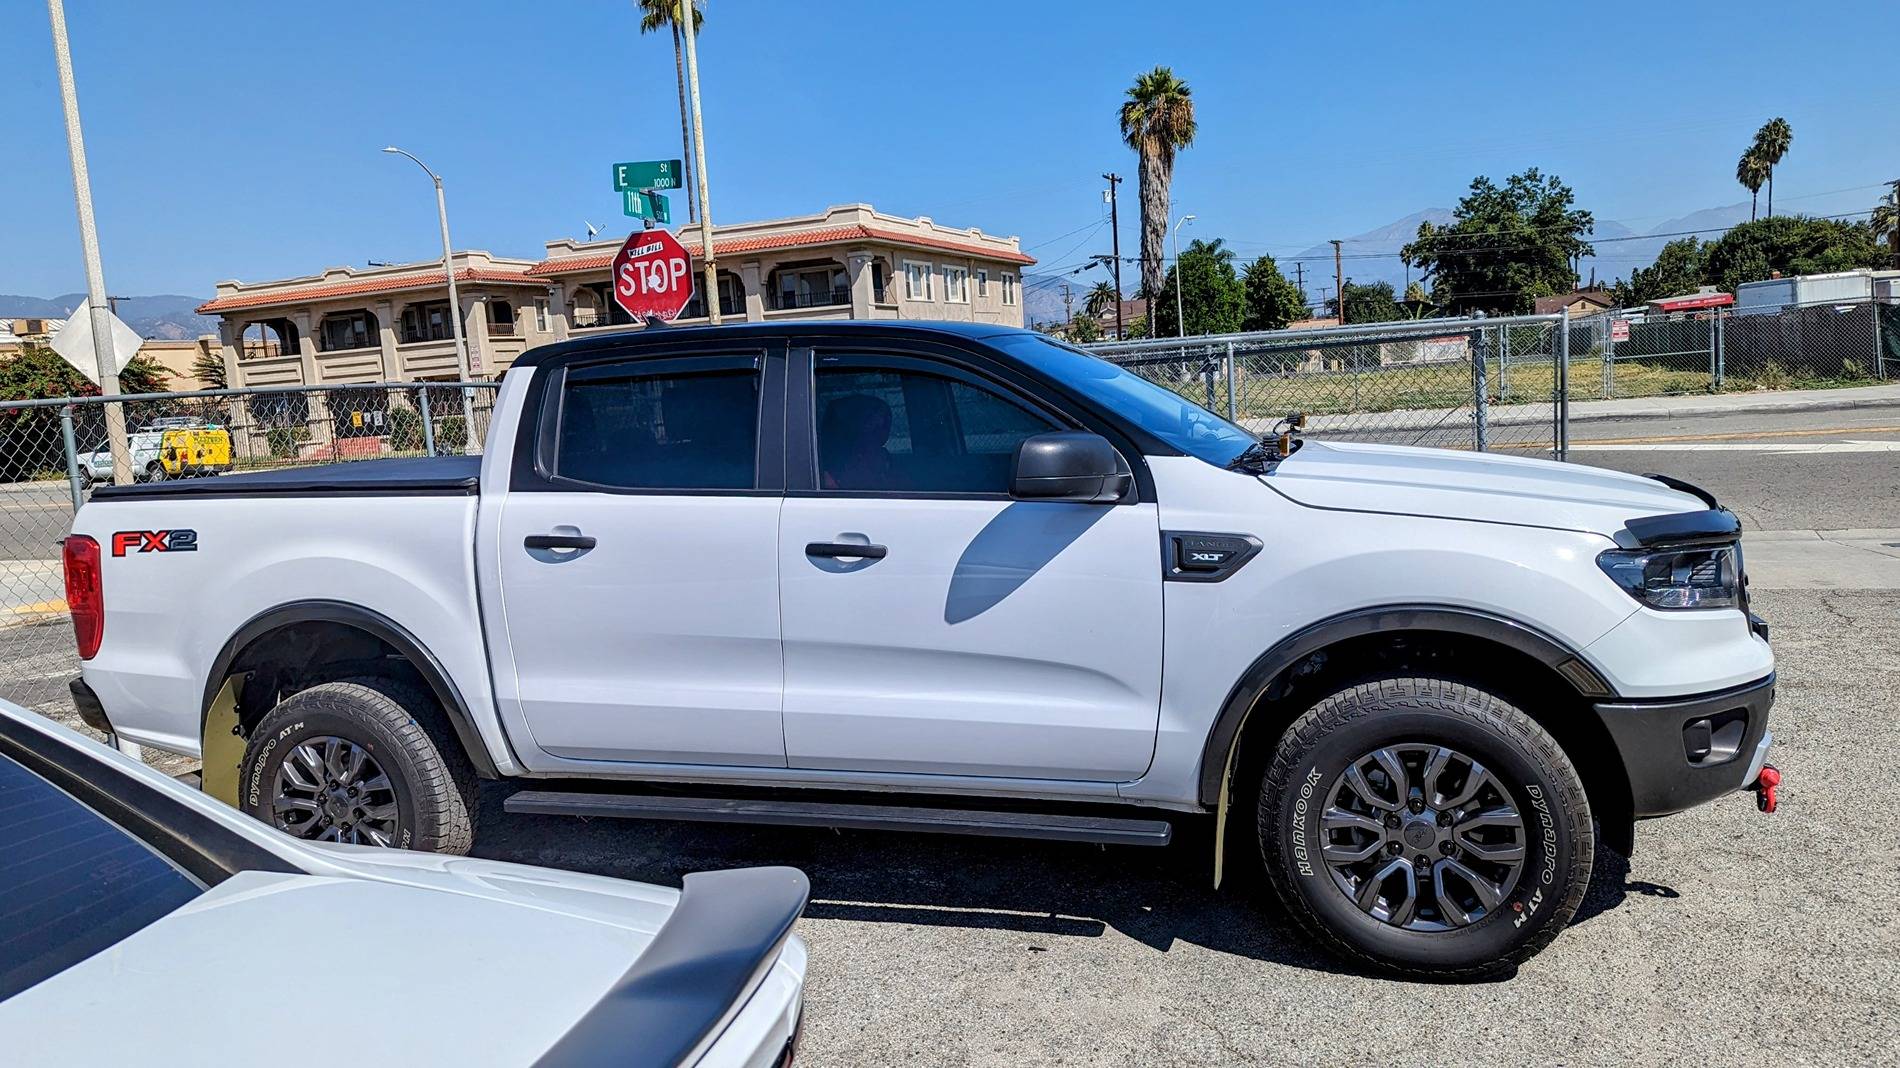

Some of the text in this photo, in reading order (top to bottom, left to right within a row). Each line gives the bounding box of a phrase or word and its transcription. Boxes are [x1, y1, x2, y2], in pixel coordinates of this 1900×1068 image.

[618, 163, 668, 187] E St
[653, 178, 670, 188] 1000
[627, 190, 643, 214] 11th
[619, 257, 687, 297] STOP
[111, 528, 198, 558] FX2
[1191, 553, 1224, 561] XLT
